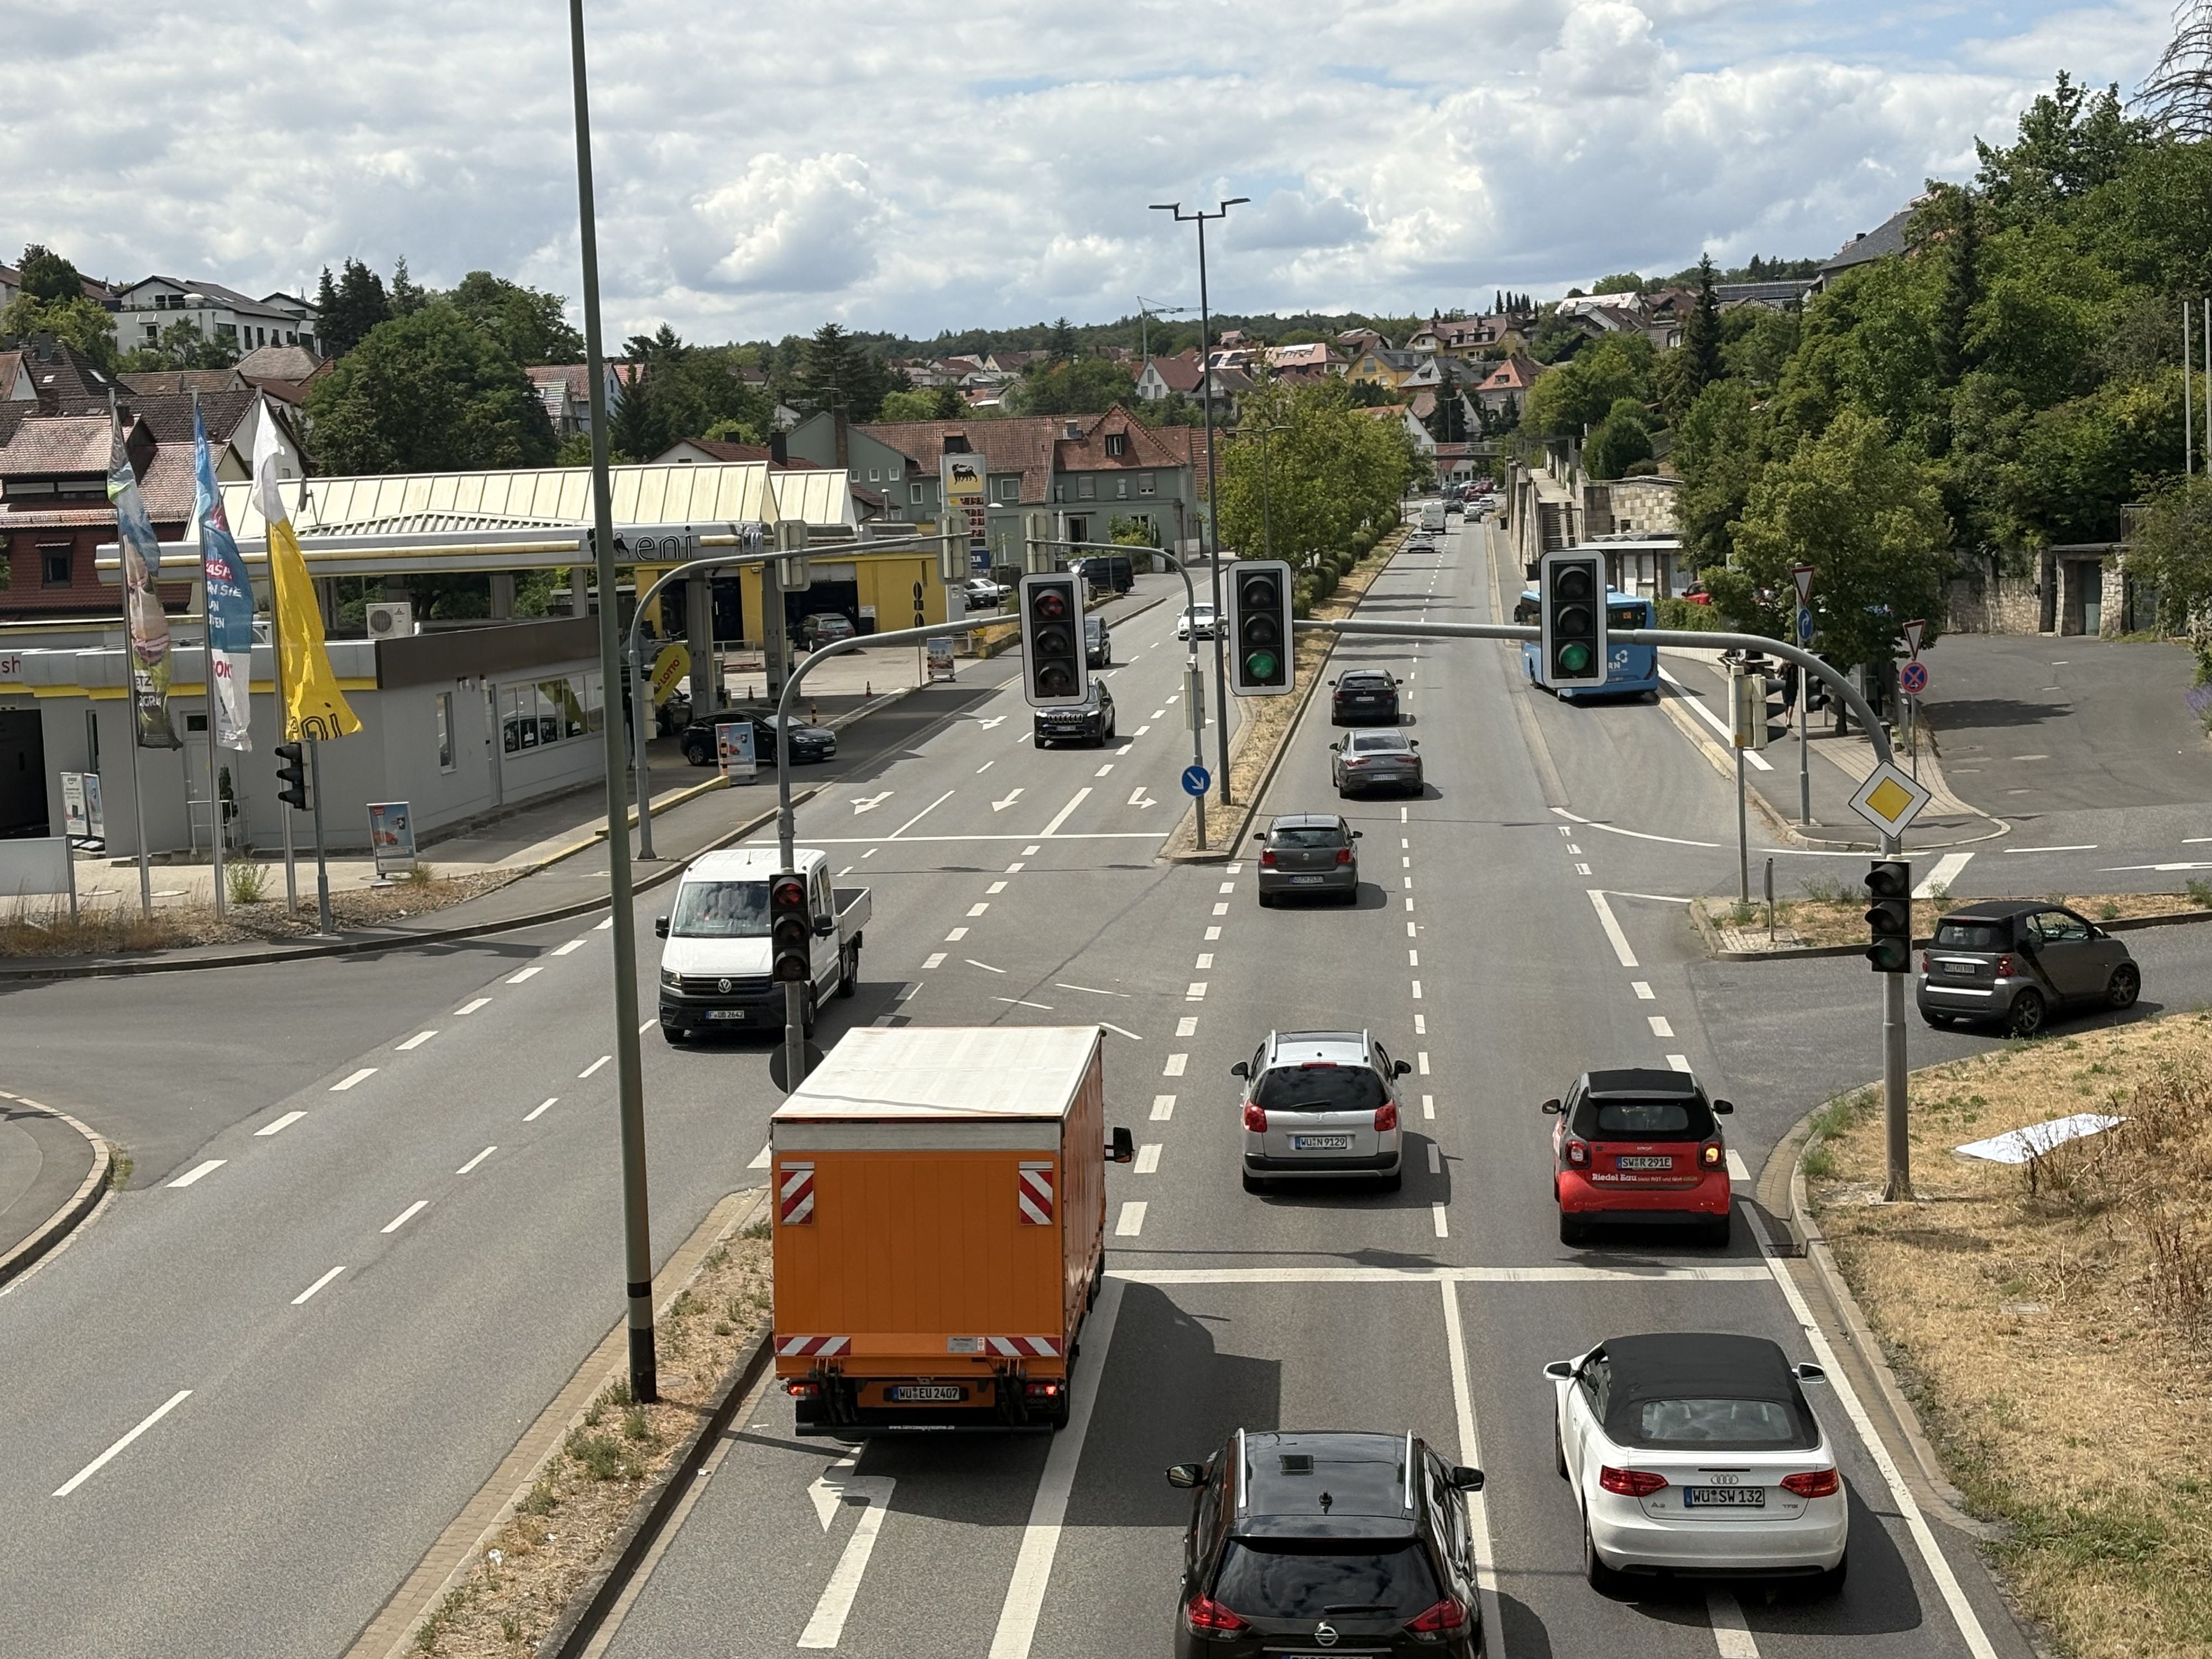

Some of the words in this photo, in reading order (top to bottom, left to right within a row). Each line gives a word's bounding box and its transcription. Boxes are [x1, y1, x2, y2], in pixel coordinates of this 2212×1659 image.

[635, 525, 692, 561] eni
[659, 659, 680, 685] LOTTO
[1317, 1138, 1323, 1146] N
[1324, 1138, 1345, 1146] 9129
[1623, 1158, 1634, 1167] SW
[1640, 1158, 1646, 1167] R
[1648, 1158, 1671, 1167] 291E
[899, 1387, 912, 1399] WÜ
[919, 1387, 932, 1399] EU
[933, 1387, 958, 1399] 2407
[1693, 1489, 1710, 1503] WÜ
[1718, 1490, 1735, 1503] SW
[1738, 1490, 1763, 1503] 132
